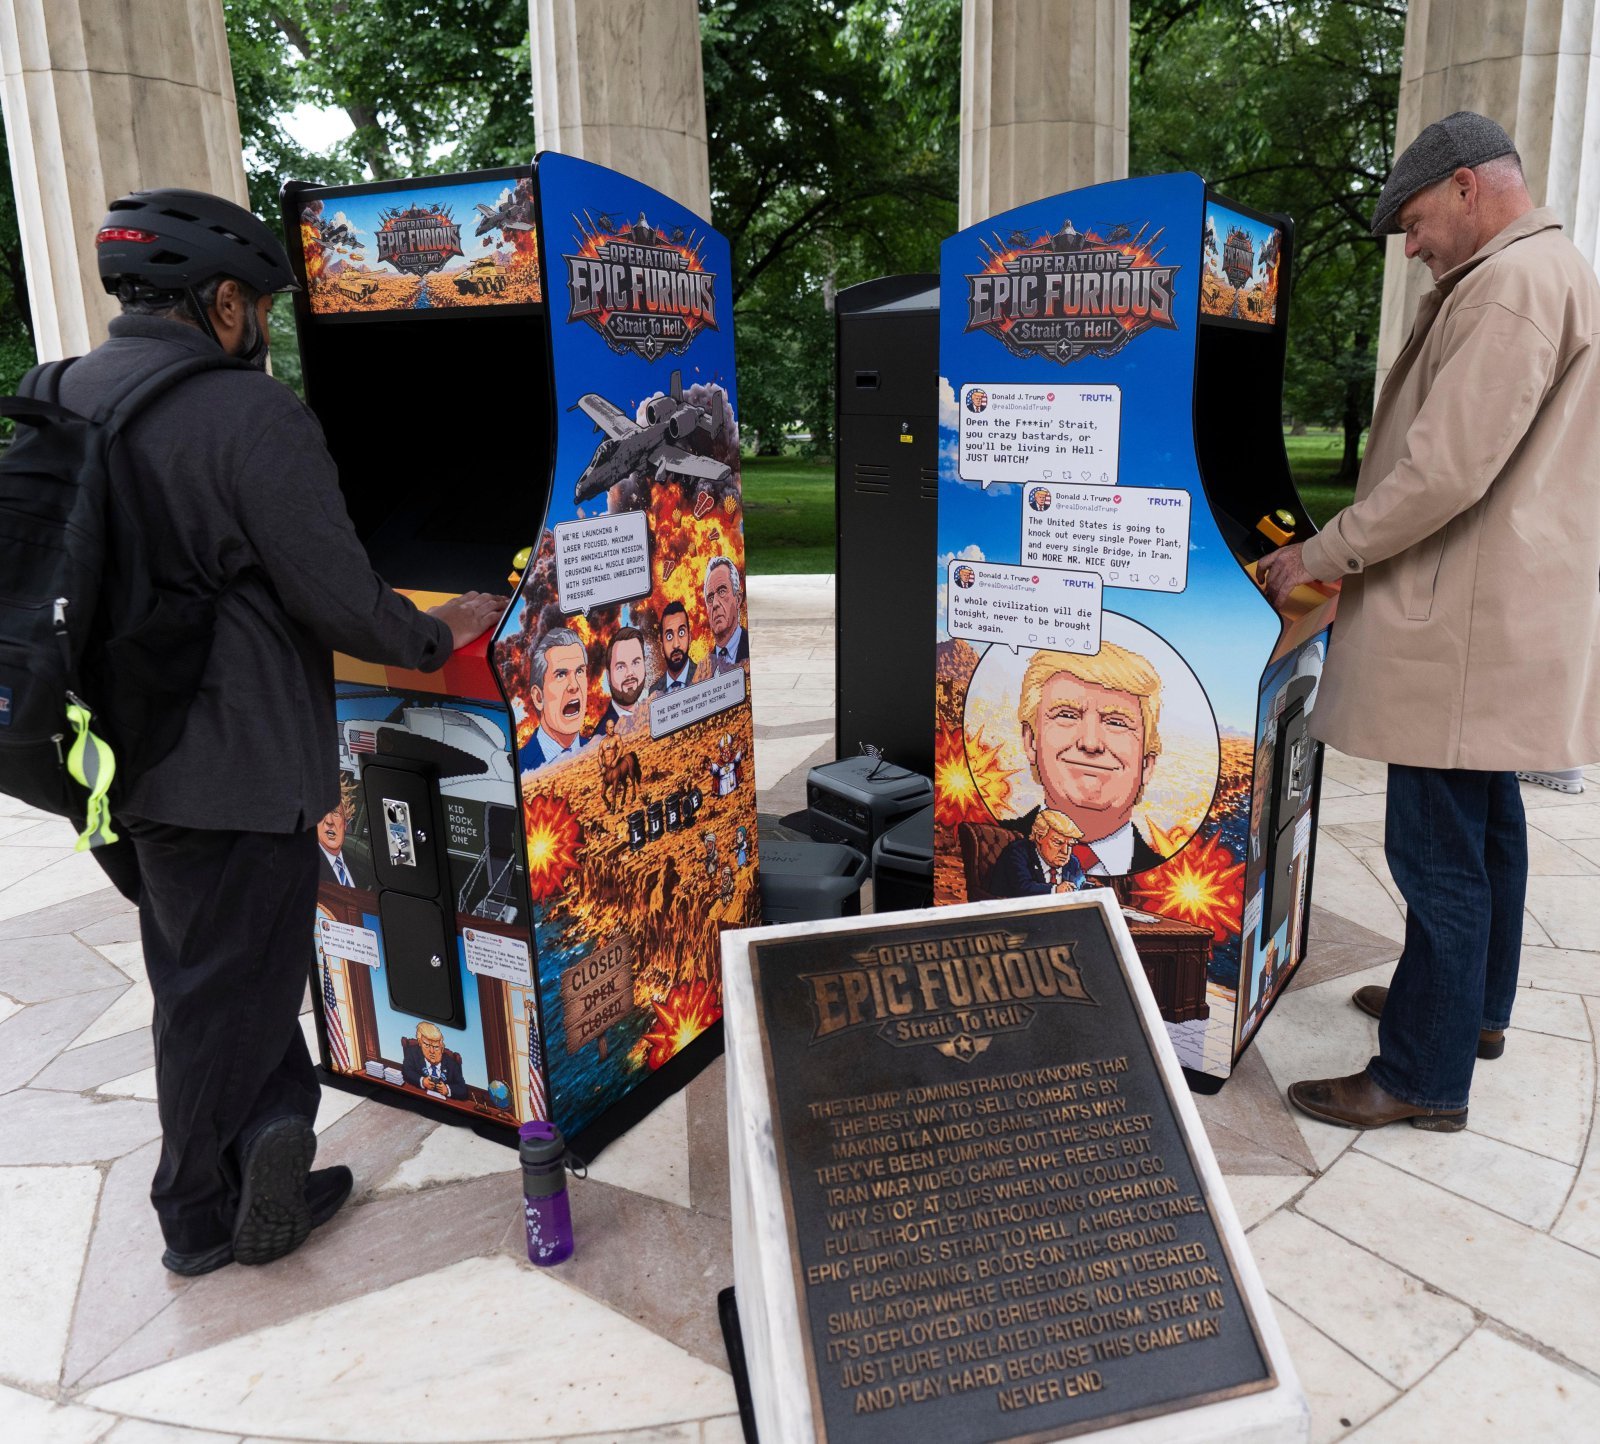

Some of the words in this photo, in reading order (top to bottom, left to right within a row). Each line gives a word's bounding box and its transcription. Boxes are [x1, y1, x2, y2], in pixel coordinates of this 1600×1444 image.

[397, 218, 437, 230] OPERATION
[377, 231, 407, 256] EPIC
[409, 225, 462, 252] FURIOUS
[401, 254, 419, 264] Strait
[428, 252, 439, 263] Hell
[609, 244, 679, 270] OPERATION
[1021, 252, 1118, 273] OPERATION
[570, 260, 627, 314] EPIC
[631, 267, 716, 320] FURIOUS
[972, 274, 1038, 326] EPIC
[1045, 270, 1171, 321] FURIOUS
[617, 316, 647, 334] Strait
[650, 318, 661, 335] To
[663, 319, 681, 336] Hell
[1021, 323, 1061, 338] Strait
[1064, 322, 1080, 338] To
[1084, 321, 1111, 337] Hell
[966, 417, 988, 427] Open
[994, 418, 1010, 426] the
[1058, 419, 1097, 429] Strait,
[988, 431, 1016, 439] crazy
[1022, 431, 1072, 441] bastards,
[965, 442, 994, 450] you'll
[1017, 443, 1049, 453] living
[1072, 445, 1094, 454] Hell
[965, 453, 988, 461] JUST
[993, 454, 1028, 463] WATCH!
[562, 532, 579, 541] WE'RE
[582, 526, 612, 537] LAUNCHING
[1028, 516, 1042, 525] The
[1047, 518, 1074, 527] United
[1079, 520, 1107, 529] States
[1126, 524, 1150, 533] going
[1155, 525, 1165, 533] to
[563, 543, 580, 553] LASER
[583, 538, 609, 549] FOCUSED,
[611, 534, 633, 544] MAXIMUM
[1028, 528, 1050, 537] knock
[1072, 532, 1095, 542] every
[1099, 534, 1124, 544] single
[1128, 536, 1151, 545] Power
[1156, 538, 1181, 548] Plant,
[564, 556, 578, 565] REPS
[580, 548, 619, 561] ANNIHILATION
[1028, 540, 1041, 548] and
[1045, 542, 1068, 552] every
[1072, 544, 1098, 554] single
[1103, 546, 1133, 557] Bridge,
[1138, 549, 1146, 557] in
[1151, 550, 1172, 559] Iran.
[564, 565, 591, 577] CRUSHING
[593, 563, 603, 571] ALL
[605, 558, 624, 568] MUSCLE
[626, 554, 644, 564] GROUPS
[1027, 552, 1037, 560] NO
[1042, 553, 1062, 562] MORE
[1067, 555, 1080, 563] MR.
[1085, 557, 1105, 566] NICE
[1110, 559, 1130, 568] GUY!
[566, 580, 579, 589] WITH
[613, 565, 645, 578] UNRELENTING
[979, 571, 1000, 579] Donald
[1011, 575, 1029, 583] Trump
[566, 588, 595, 600] PRESSURE.
[964, 596, 987, 606] whole
[992, 599, 1048, 613] civilization
[1053, 606, 1071, 615] will
[1077, 608, 1091, 617] die
[954, 608, 988, 619] tonight,
[993, 613, 1018, 622] never
[1038, 617, 1048, 625] be
[1054, 620, 1090, 631] brought
[954, 620, 972, 629] back
[977, 624, 1003, 633] again.
[448, 804, 464, 814] KID
[449, 815, 473, 826] ROCK
[450, 825, 478, 837] FORCE
[452, 835, 468, 845] ONE
[878, 934, 1004, 967] OPERATION
[571, 944, 623, 991] CLOSED
[810, 966, 914, 1037] EPIC
[916, 945, 1096, 1012] FURIOUS
[896, 1015, 952, 1040] Strait
[957, 1011, 979, 1032] To
[986, 1005, 1020, 1028] Hell
[808, 1099, 843, 1119] THE
[847, 1090, 902, 1113] TRUMP
[903, 1071, 1035, 1104] ADMINISTRATION
[1035, 1062, 1094, 1084] KNOWS
[1094, 1056, 1132, 1075] THAT
[827, 1184, 869, 1207] IRAN
[870, 1177, 911, 1200] WAR
[911, 1167, 966, 1192] VIDEO
[966, 1159, 1017, 1183] GAME
[1018, 1151, 1063, 1174] HYPE
[1121, 1135, 1154, 1156] BUT
[826, 1207, 869, 1231] WHY
[870, 1199, 918, 1224] STOP
[920, 1194, 943, 1215] AT
[943, 1185, 995, 1211] CLIPS
[993, 1176, 1046, 1201] WHEN
[1046, 1170, 1081, 1192] YOU
[1081, 1160, 1139, 1186] COULD
[1138, 1155, 1166, 1175] GO
[871, 1214, 969, 1249] THROTTLE?
[971, 1192, 1087, 1230] INTRODUCING
[1086, 1176, 1180, 1208] OPERATION
[838, 1357, 890, 1389] JUST
[889, 1346, 943, 1378] PURE
[944, 1325, 1042, 1366] PIXELATED
[1203, 1288, 1226, 1310] IN
